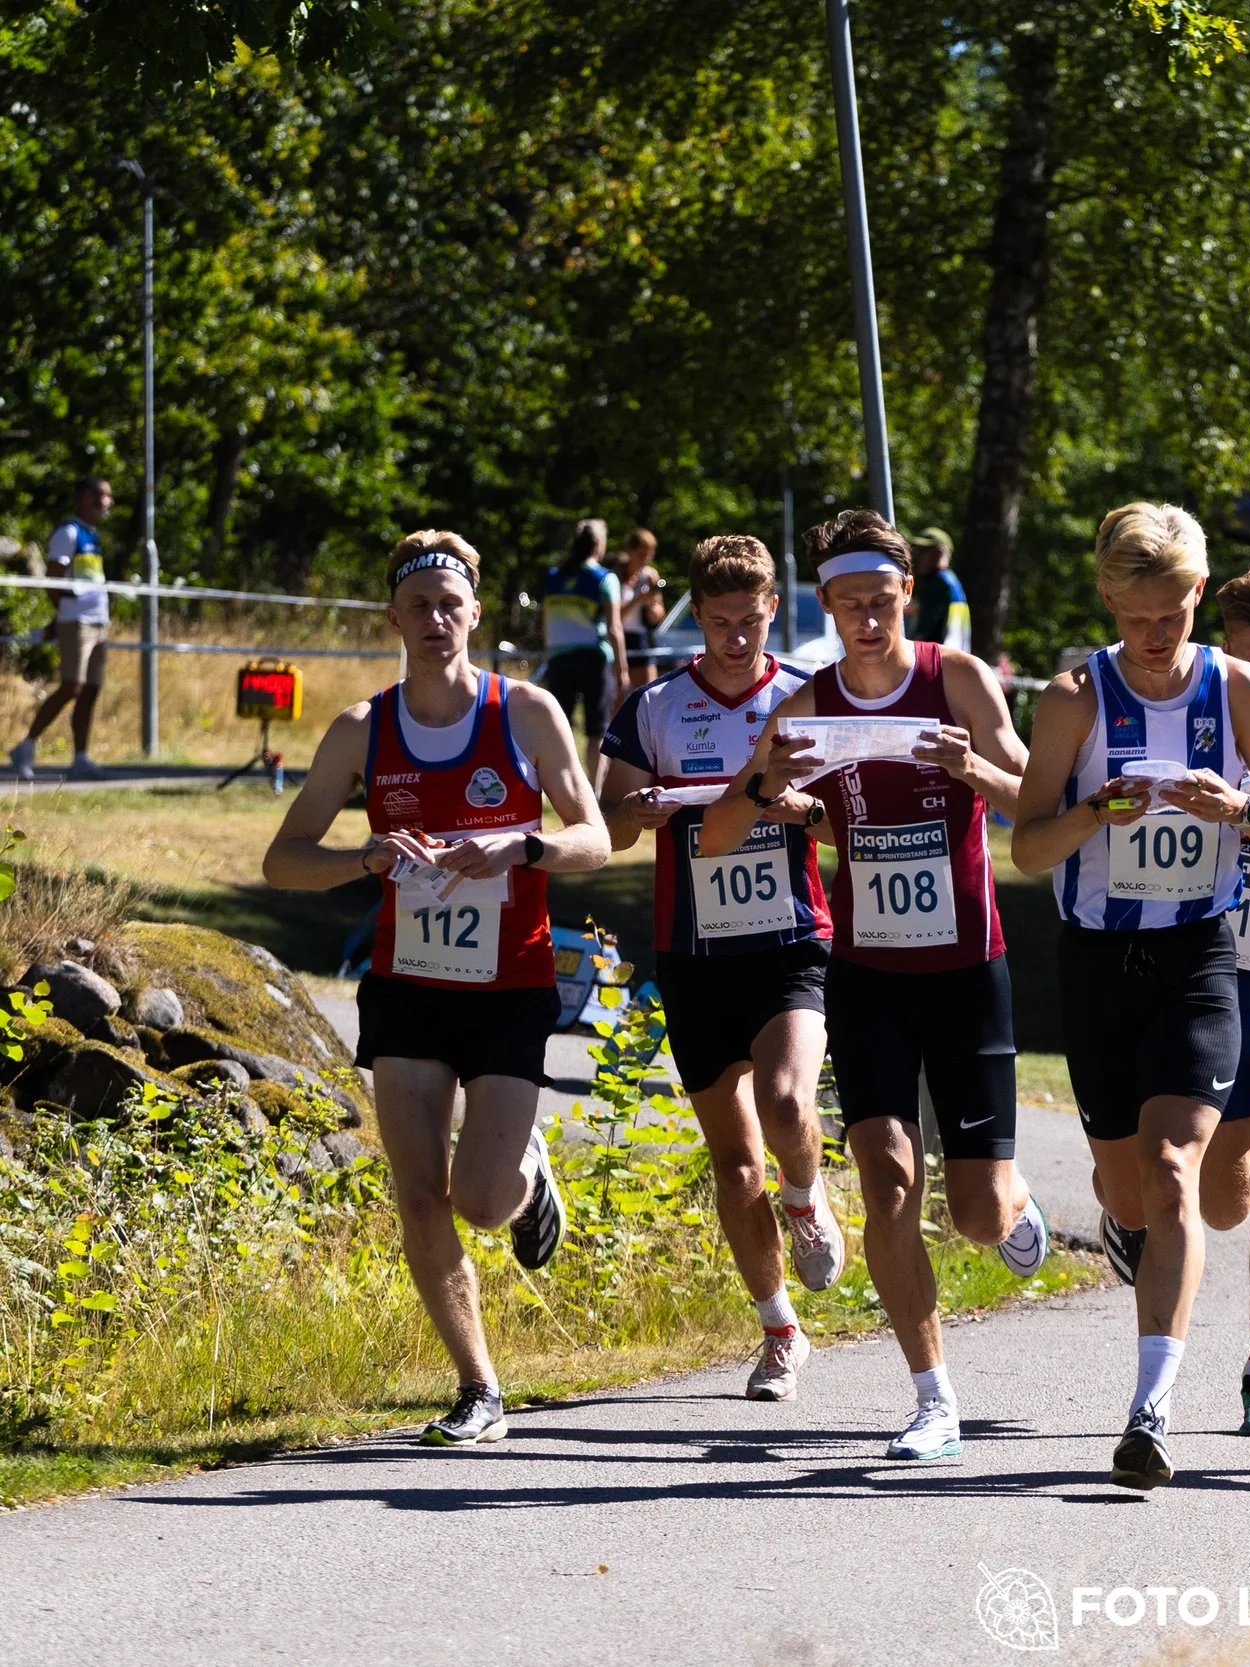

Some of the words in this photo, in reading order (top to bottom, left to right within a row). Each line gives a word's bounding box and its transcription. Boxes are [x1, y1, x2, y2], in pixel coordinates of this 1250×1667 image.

[396, 553, 467, 583] TRIMTEX
[681, 713, 721, 724] headlight
[686, 741, 716, 752] Kumla
[1108, 748, 1146, 756] noname
[376, 773, 421, 786] TRIMTEX
[456, 813, 517, 826] LUMONITE
[853, 829, 942, 850] bagheera
[1129, 825, 1204, 869] 109
[877, 850, 928, 860] SPRINTDISTANS
[710, 861, 777, 906] 105
[1166, 883, 1212, 893] VOLVO
[868, 869, 938, 915] 108
[748, 915, 792, 926] VOLVO
[413, 905, 480, 949] 112
[905, 929, 954, 939] VOLVO
[444, 966, 493, 975] VOLVO
